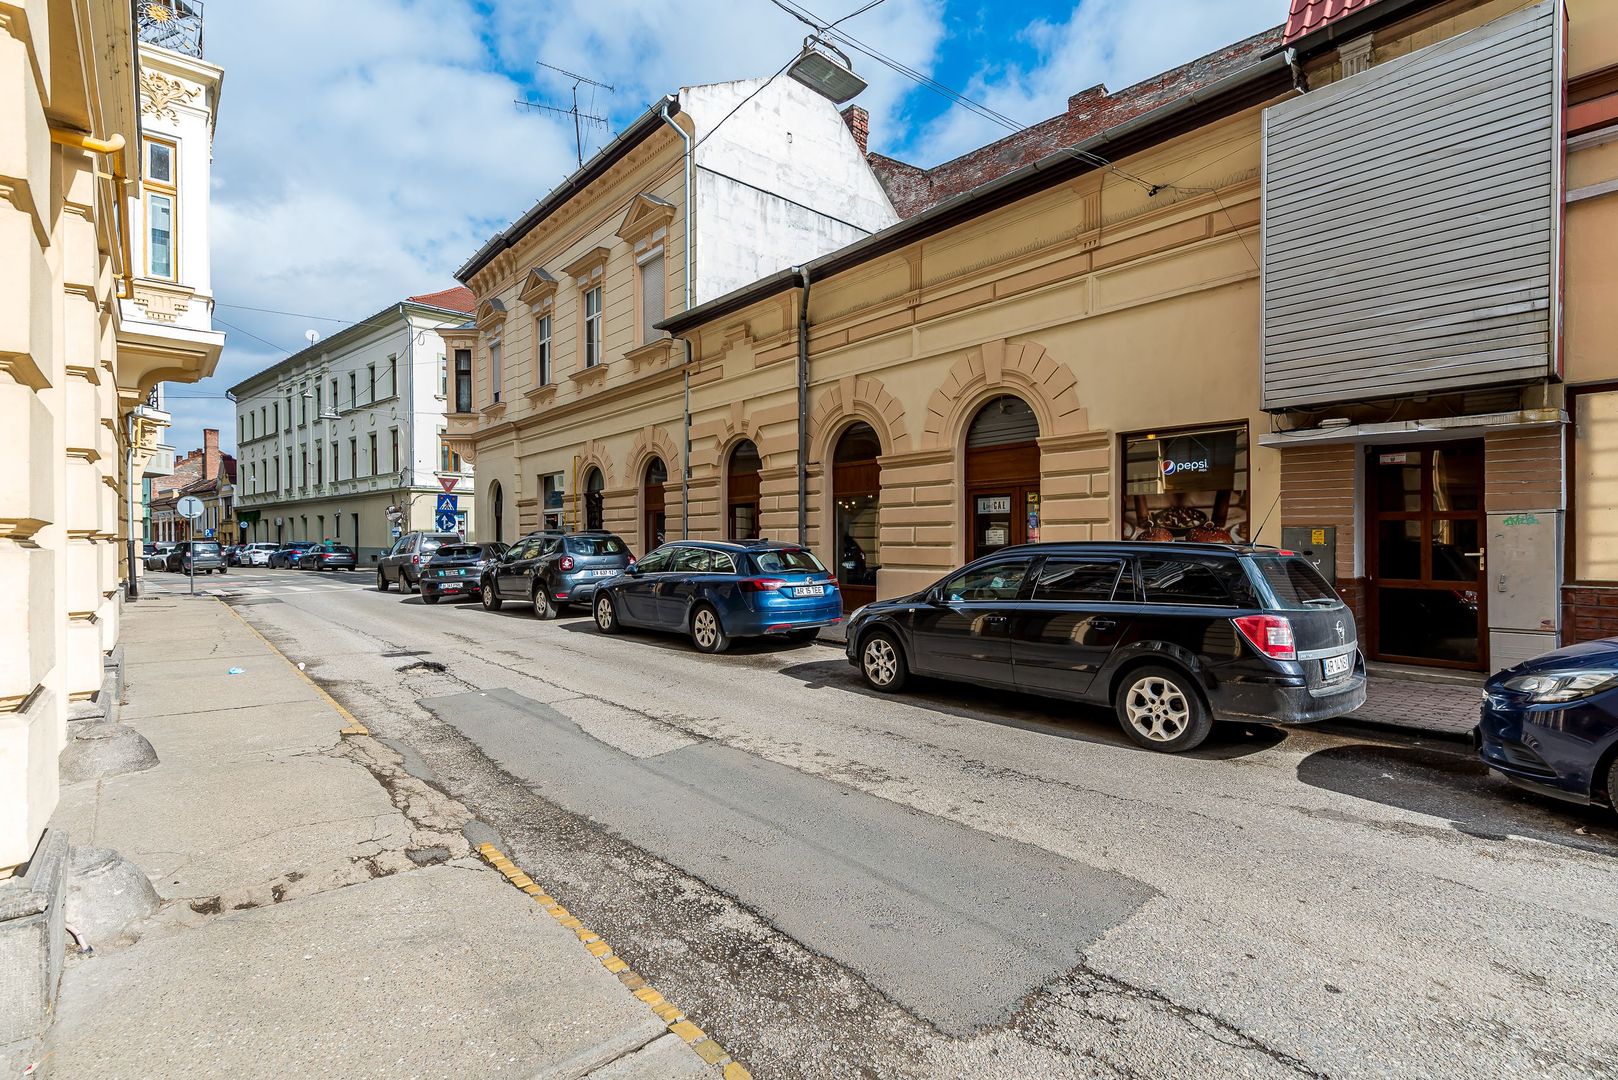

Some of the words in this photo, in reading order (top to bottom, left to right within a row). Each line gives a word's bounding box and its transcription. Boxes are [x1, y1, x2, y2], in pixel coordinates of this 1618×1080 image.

[1177, 459, 1208, 472] pepsi
[797, 587, 805, 595] AR
[811, 586, 823, 594] TEE
[1327, 660, 1335, 672] AR
